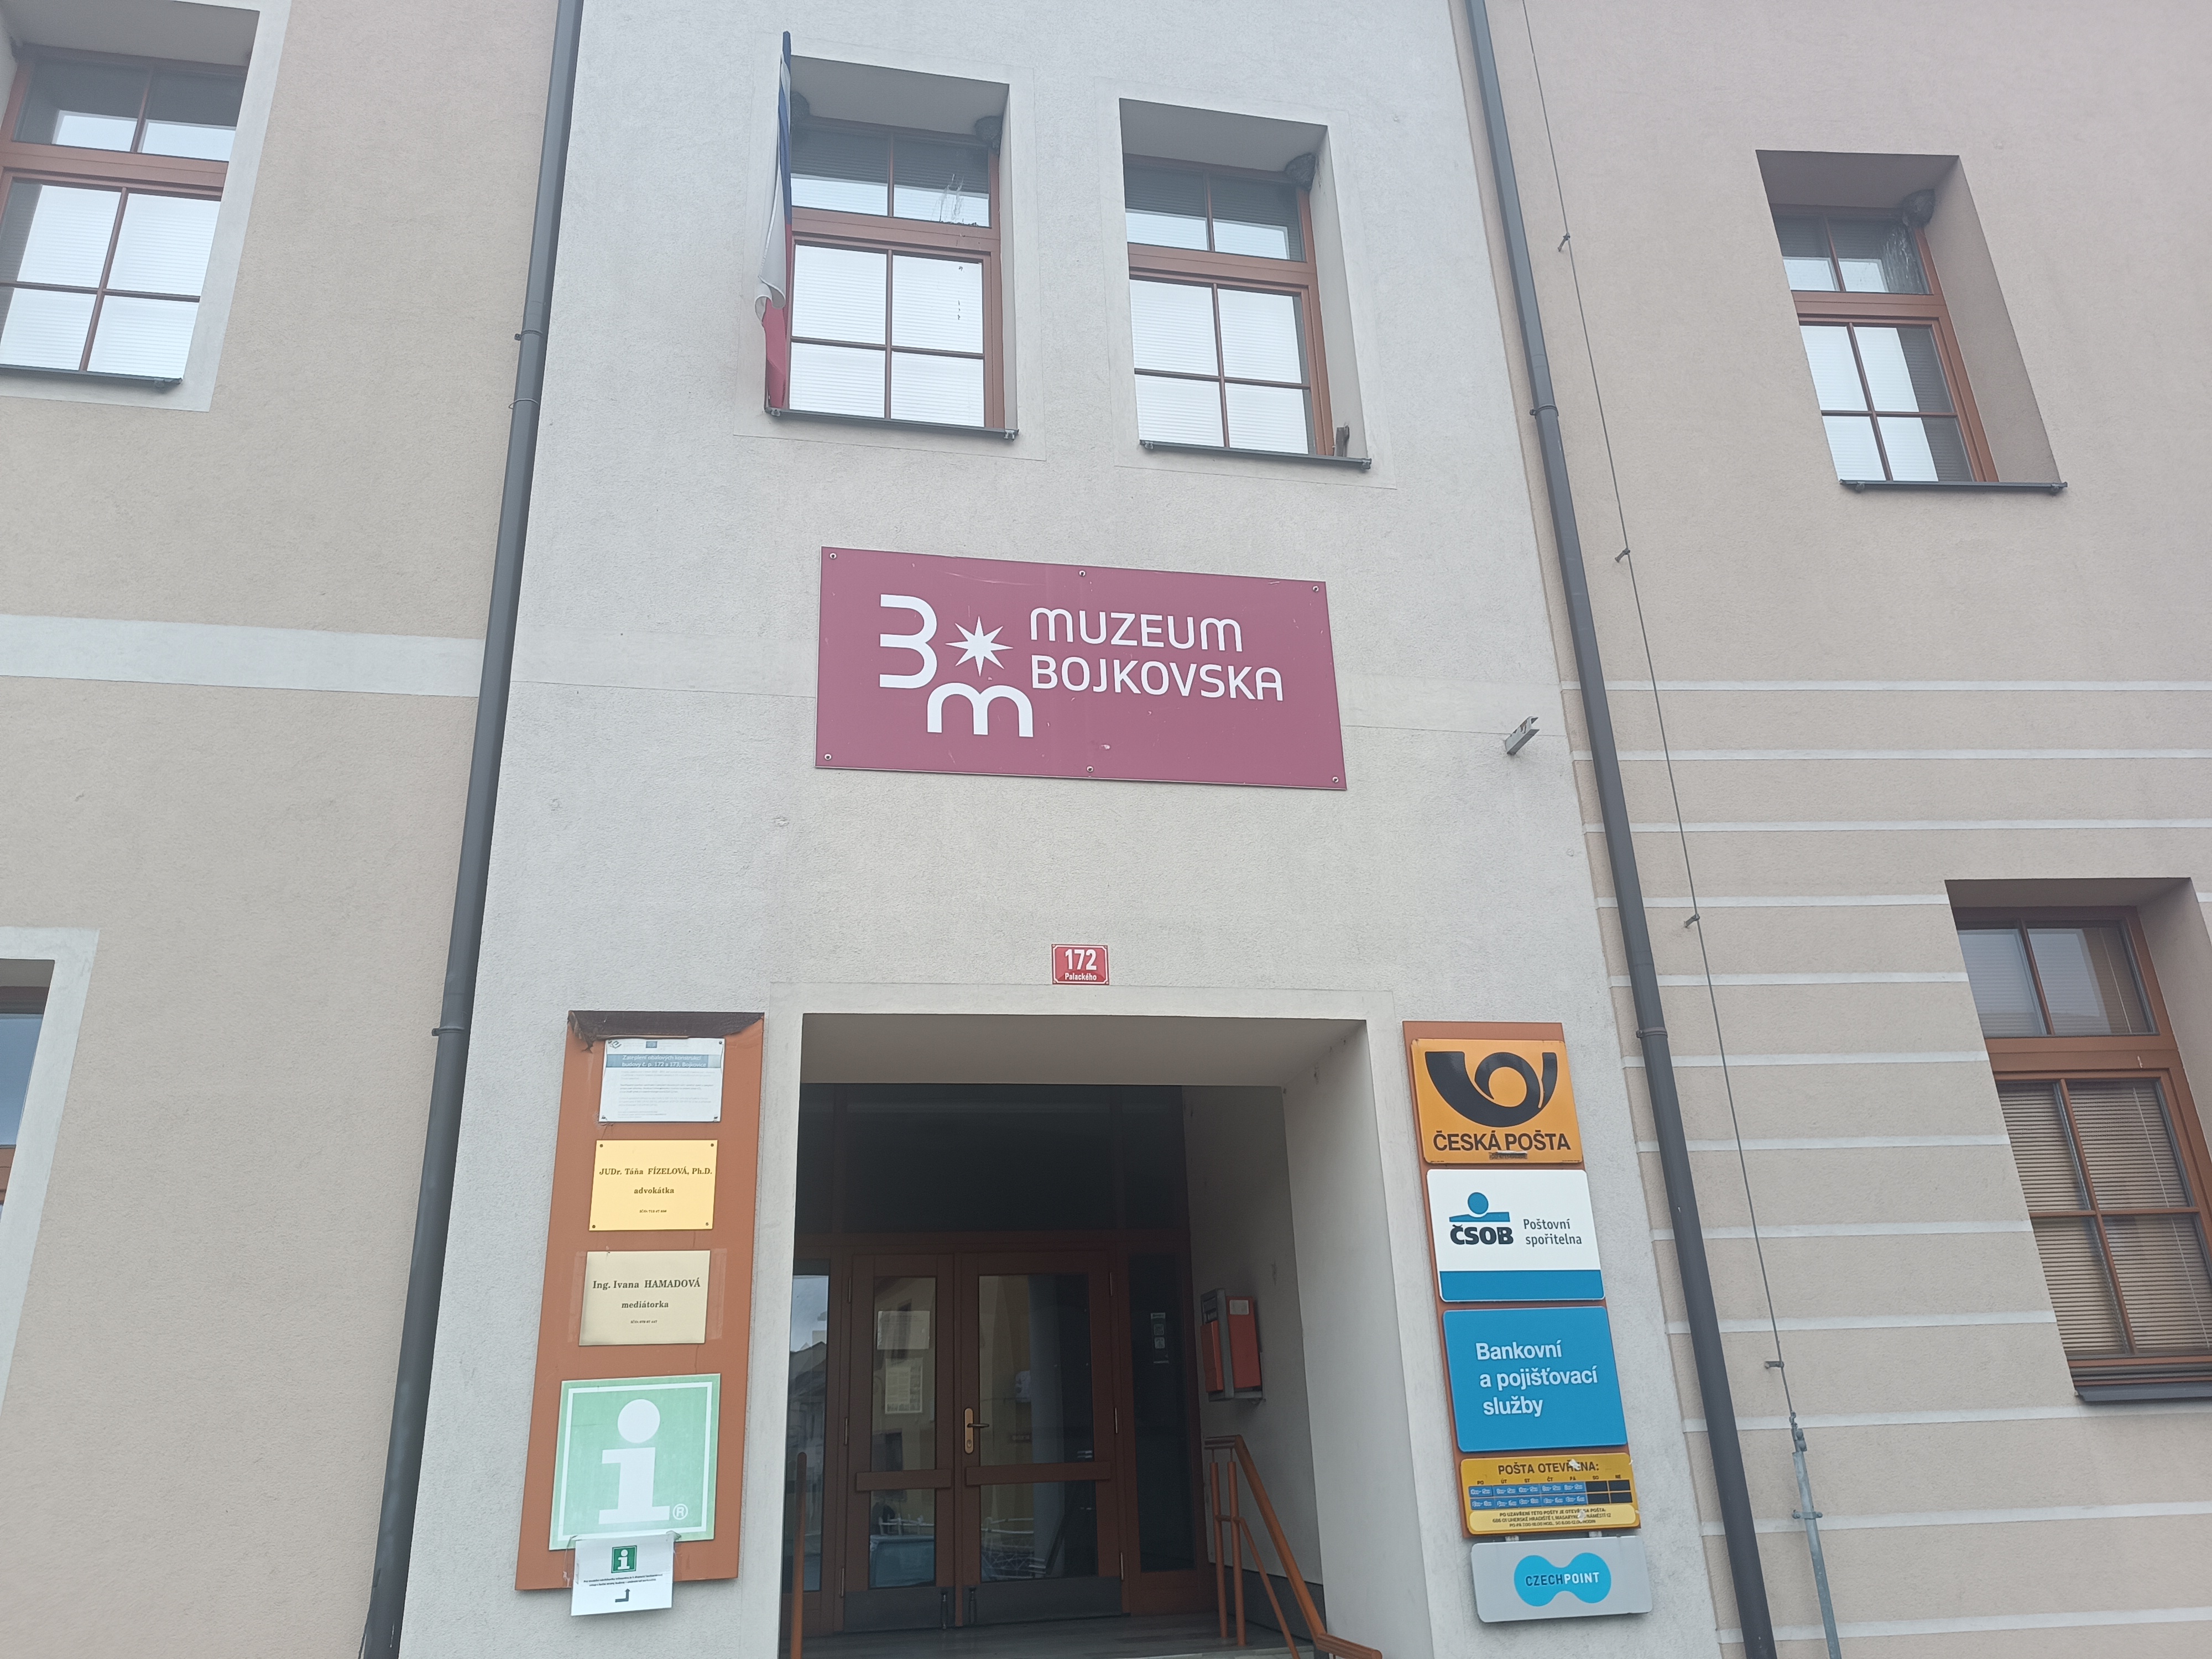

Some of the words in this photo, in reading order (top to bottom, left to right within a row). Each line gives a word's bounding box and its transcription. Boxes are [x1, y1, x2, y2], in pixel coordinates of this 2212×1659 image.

[1030, 607, 1243, 652] MUZEUM
[1031, 655, 1284, 702] BOJKOVSKA
[1065, 949, 1097, 970] 172
[1065, 972, 1097, 980] Palackého
[1433, 1130, 1501, 1151] ČESKÁ
[1505, 1130, 1571, 1151] POŠTA
[647, 1166, 690, 1175] FÍZELOVÁ,
[1450, 1224, 1514, 1245] ČSOB
[1523, 1219, 1571, 1230] Poštovní
[1525, 1233, 1582, 1247] spořitelna
[592, 1280, 611, 1290] Ing.
[613, 1280, 639, 1288] Ivana
[644, 1277, 701, 1288] HAMADOVÁ
[1476, 1339, 1562, 1360] Bankovní
[1480, 1374, 1491, 1387] a
[1497, 1365, 1598, 1391] pojišťovací
[1483, 1396, 1543, 1417] služby
[1498, 1462, 1535, 1475] POŠTA
[1525, 1572, 1600, 1587] CZECHPOINT
